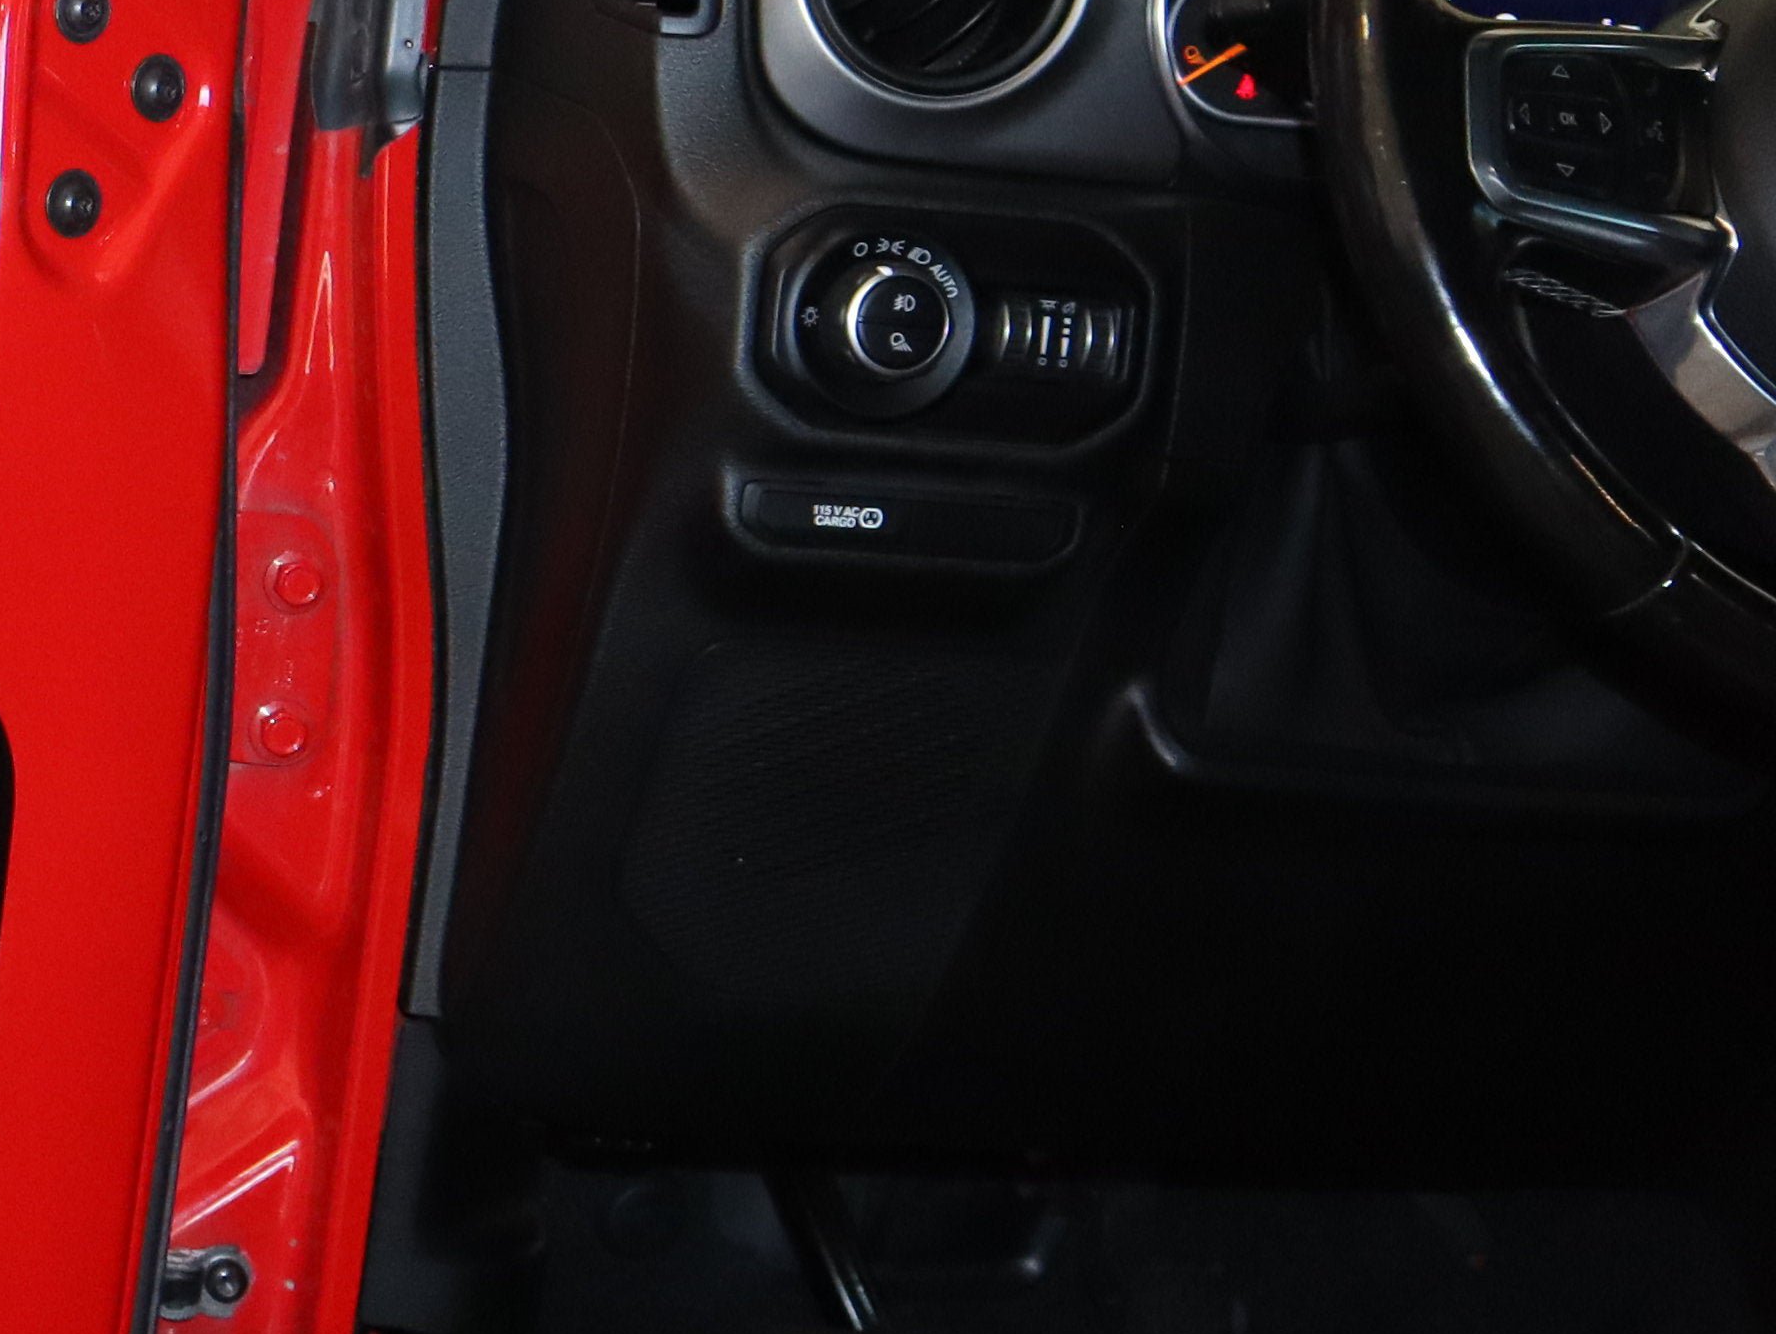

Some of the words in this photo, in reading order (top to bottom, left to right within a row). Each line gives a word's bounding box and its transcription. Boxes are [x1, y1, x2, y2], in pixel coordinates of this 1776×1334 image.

[1559, 111, 1579, 126] OK
[929, 264, 959, 299] AUTO
[813, 504, 832, 516] 115
[833, 505, 843, 516] V
[843, 506, 860, 518] AC
[814, 515, 857, 529] CARGO
